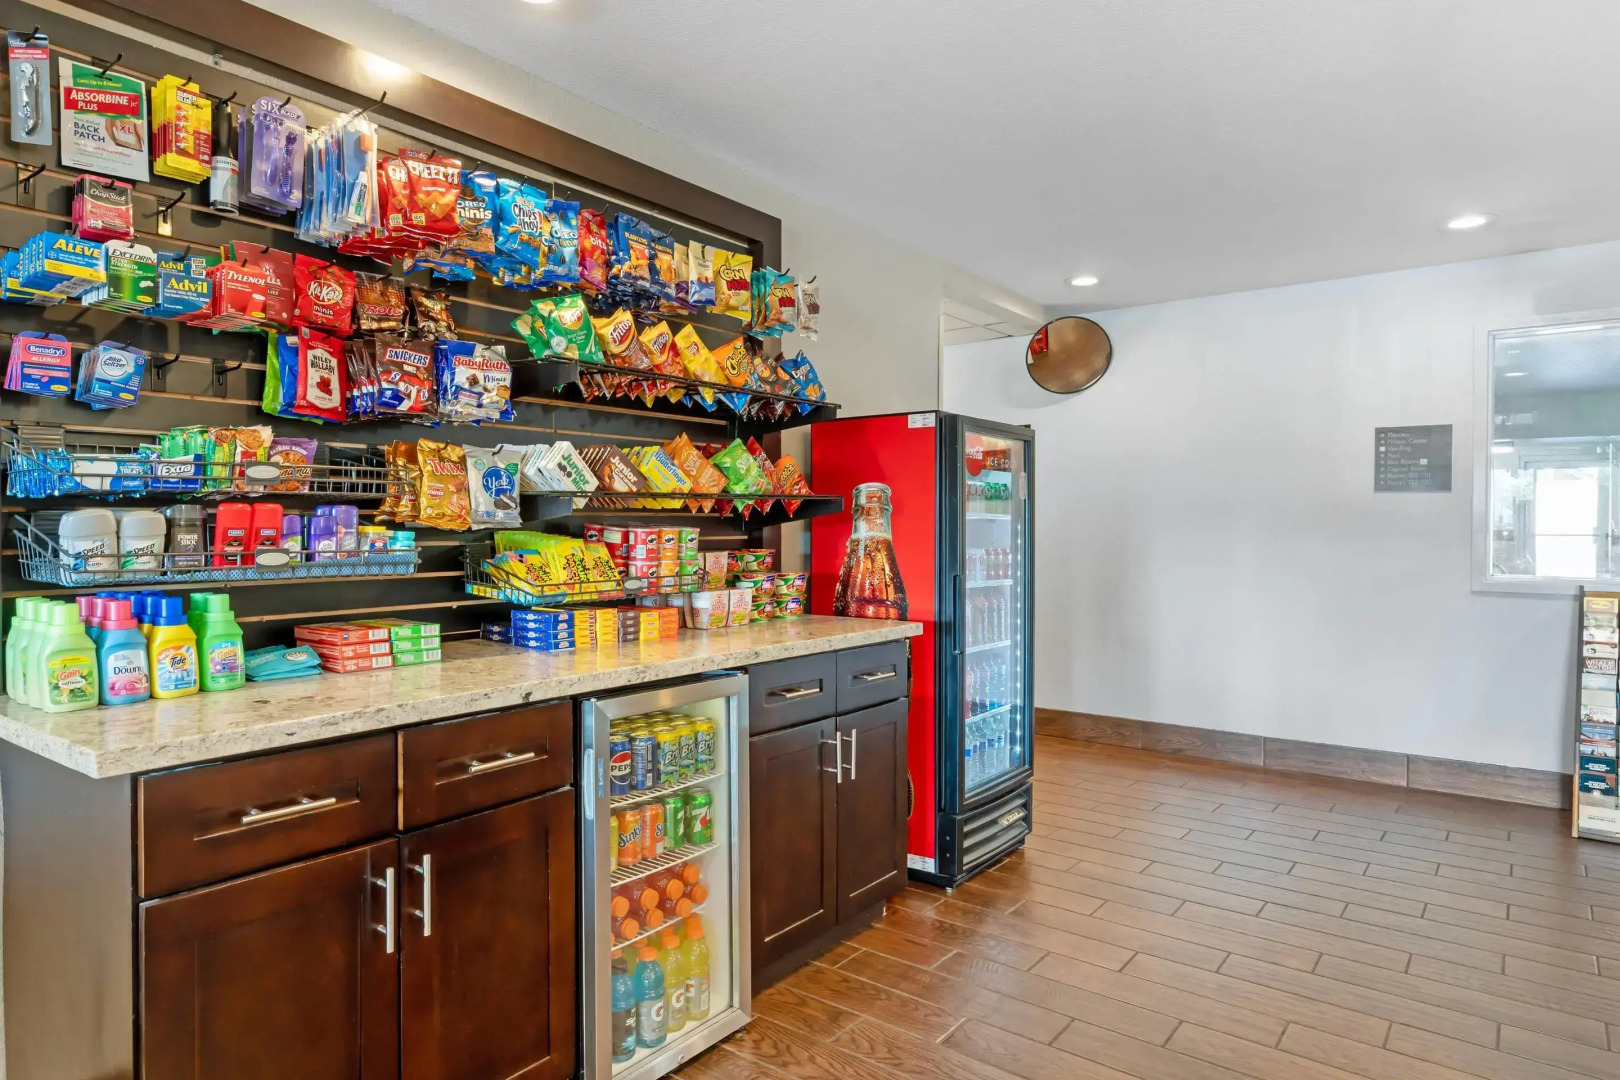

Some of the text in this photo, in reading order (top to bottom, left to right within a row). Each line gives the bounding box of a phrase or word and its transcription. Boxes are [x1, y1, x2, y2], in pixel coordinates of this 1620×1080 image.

[69, 89, 129, 106] ABSORBINE
[77, 101, 98, 111] PLUS
[260, 100, 281, 115] SIX
[74, 122, 100, 134] BACK
[120, 125, 133, 135] XL
[74, 130, 106, 143] PATCH
[90, 188, 127, 201] ChapStick
[513, 203, 538, 221] Chips
[625, 231, 648, 245] PLANTERS
[52, 238, 101, 258] ALEVE
[651, 242, 673, 254] PLANTERS
[111, 249, 155, 263] EXCEDRIN
[159, 260, 184, 271] Advil
[227, 270, 266, 287] TYLENOL
[719, 264, 746, 281] CORN
[166, 277, 208, 294] Advil
[726, 279, 750, 291] NUTS
[313, 304, 334, 316] minis
[609, 319, 632, 346] Fritos
[651, 332, 669, 352] Fritos
[30, 345, 63, 356] Benadryl
[312, 354, 332, 365] WILEY
[387, 349, 429, 366] SNICKERS
[310, 358, 336, 375] WALLABY
[483, 373, 507, 384] Minis
[425, 458, 465, 475] Twix
[562, 452, 590, 485] Junior
[656, 451, 688, 486] Butterfinger
[987, 457, 998, 467] ICE
[162, 463, 192, 476] Extra
[610, 455, 638, 483] Junior
[483, 470, 512, 499] York
[614, 467, 638, 493] Caramels
[81, 543, 105, 555] SPEED
[133, 543, 155, 555] SPEED
[217, 648, 235, 660] Gain
[170, 656, 187, 668] Tide
[1585, 659, 1614, 667] WHALE
[59, 668, 80, 681] Gain
[610, 763, 631, 772] PEPS
